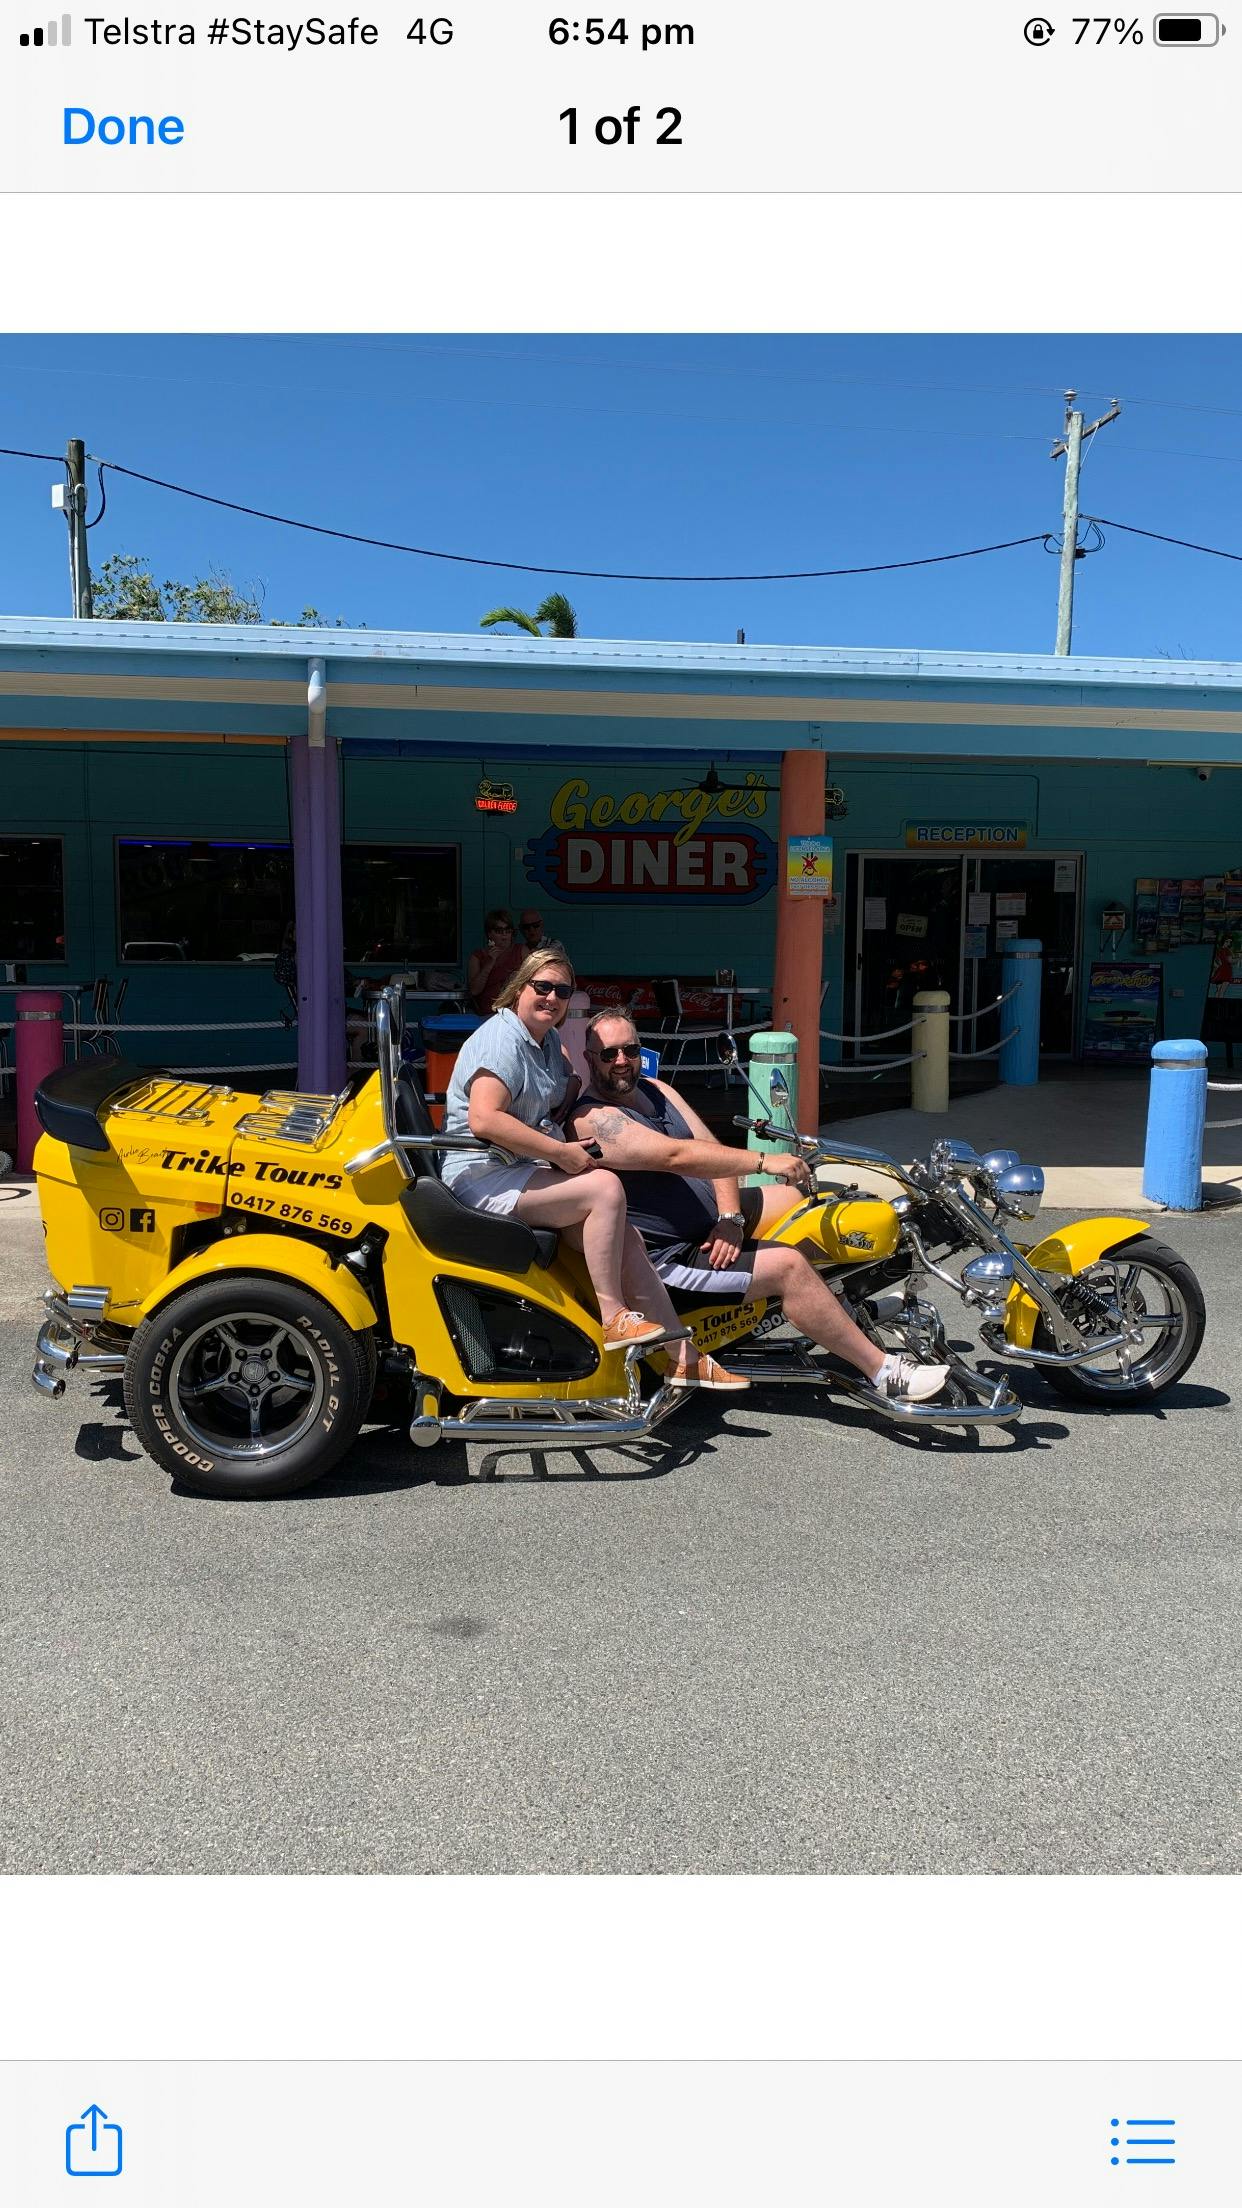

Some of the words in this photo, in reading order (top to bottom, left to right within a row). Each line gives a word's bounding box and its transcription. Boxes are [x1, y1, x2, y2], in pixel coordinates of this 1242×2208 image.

[551, 772, 768, 847] George's
[917, 826, 1018, 842] RECEPTION
[567, 838, 749, 887] DINER
[161, 1149, 245, 1177] Trike
[254, 1161, 343, 1190] Tours
[230, 1192, 275, 1212] 0417
[279, 1204, 313, 1223] 876
[318, 1214, 353, 1235] 569
[697, 1331, 718, 1347] 0417
[720, 1323, 737, 1336] 876
[740, 1315, 758, 1329] 569
[700, 1303, 754, 1332] Tours
[150, 1327, 183, 1396] COBRA
[296, 1315, 340, 1388] RADIAL
[322, 1394, 340, 1433] G/T
[152, 1404, 215, 1473] COOPER
